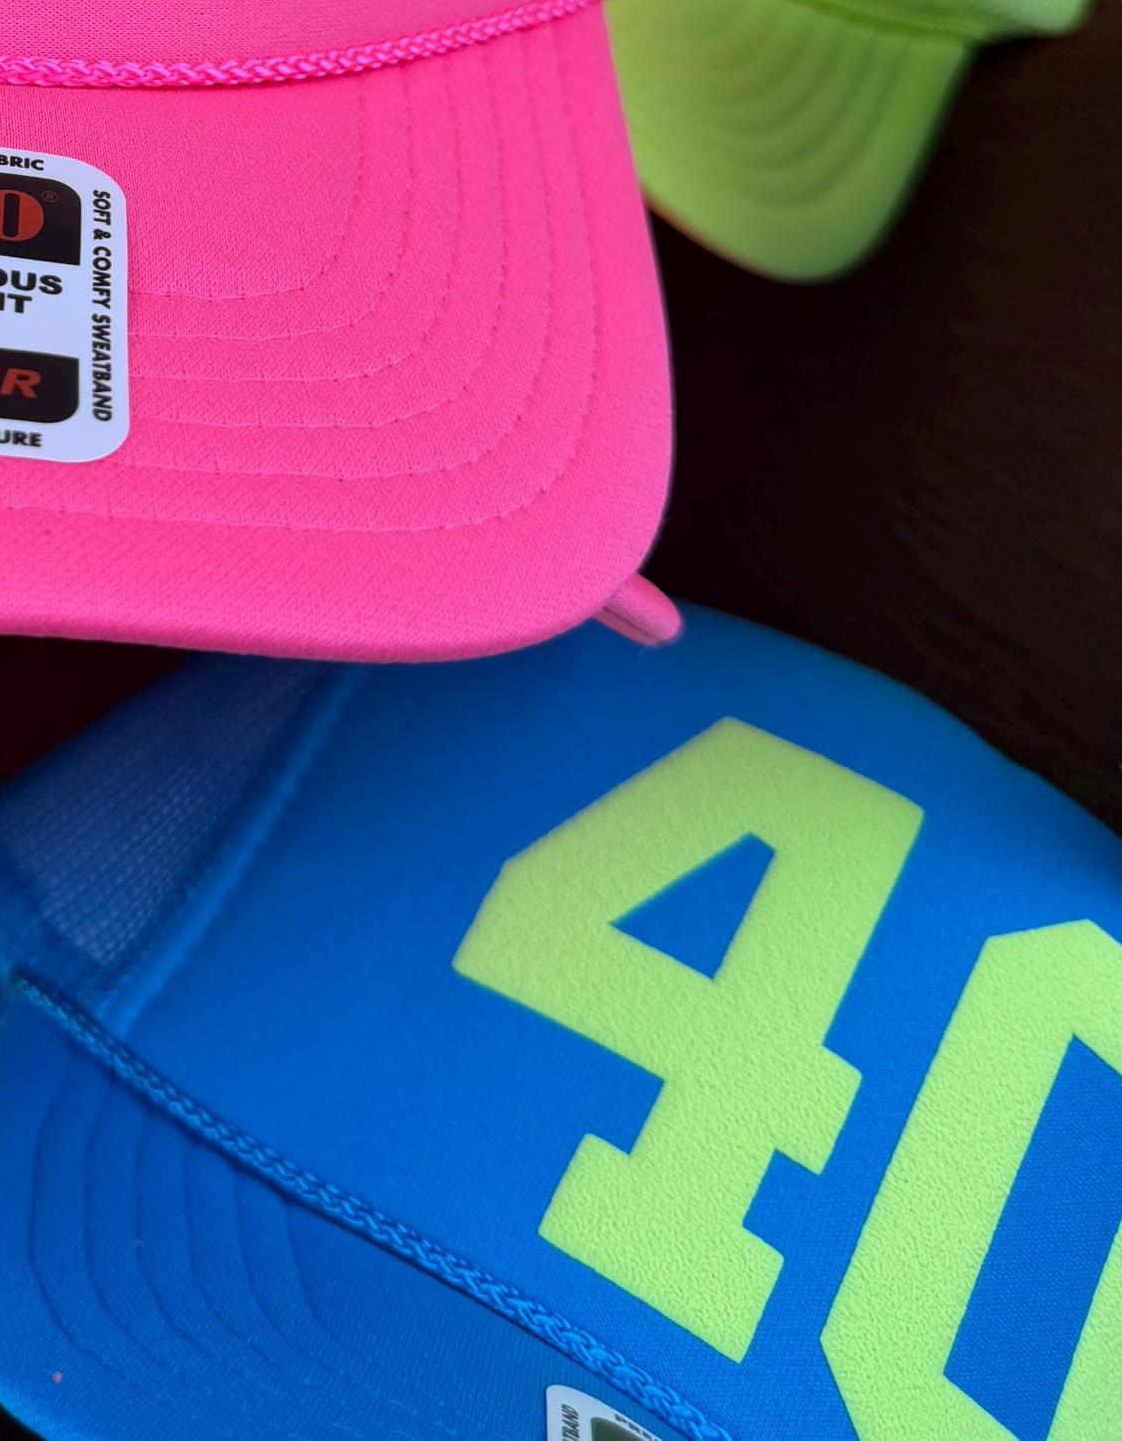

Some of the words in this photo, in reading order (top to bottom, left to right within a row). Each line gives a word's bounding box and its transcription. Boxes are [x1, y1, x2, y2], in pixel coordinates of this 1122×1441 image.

[92, 190, 111, 226] SOFT
[92, 228, 112, 241] &
[92, 246, 112, 309] COMFY
[91, 313, 113, 422] SWEATBAND
